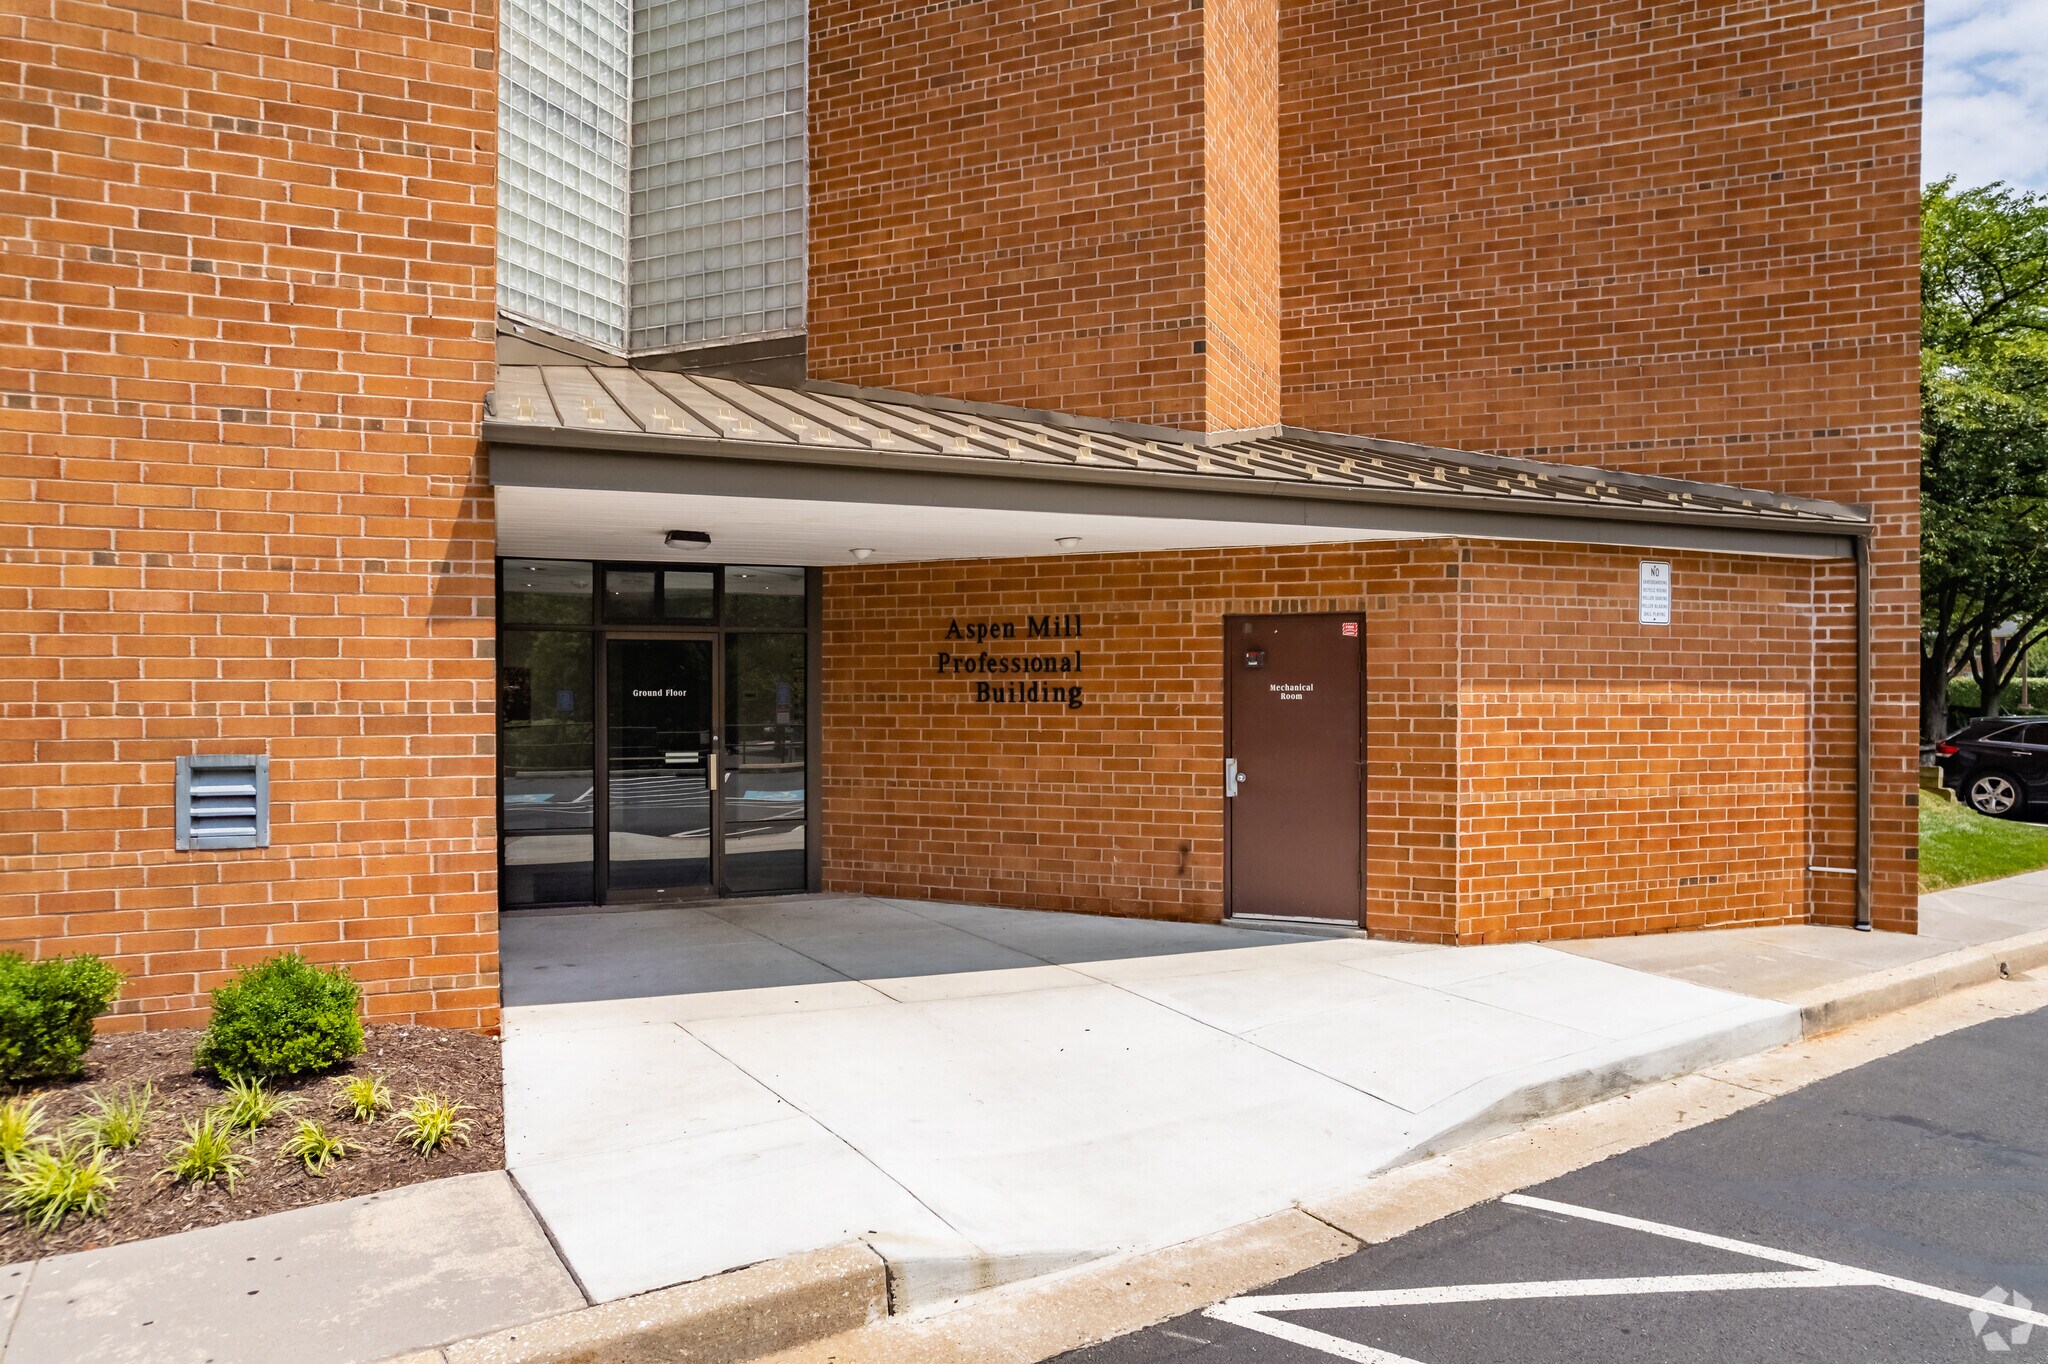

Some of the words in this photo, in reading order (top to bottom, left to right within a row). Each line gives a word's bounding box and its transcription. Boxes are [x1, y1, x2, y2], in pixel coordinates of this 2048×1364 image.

[1650, 568, 1660, 577] NO
[945, 618, 1016, 643] Aspen
[1027, 614, 1082, 638] Mill
[937, 650, 1082, 673] Professional
[1270, 683, 1314, 692] Mechanical
[632, 689, 663, 697] Ground
[665, 689, 687, 697] Floor
[976, 681, 1083, 709] Building
[1280, 692, 1303, 700] Room
